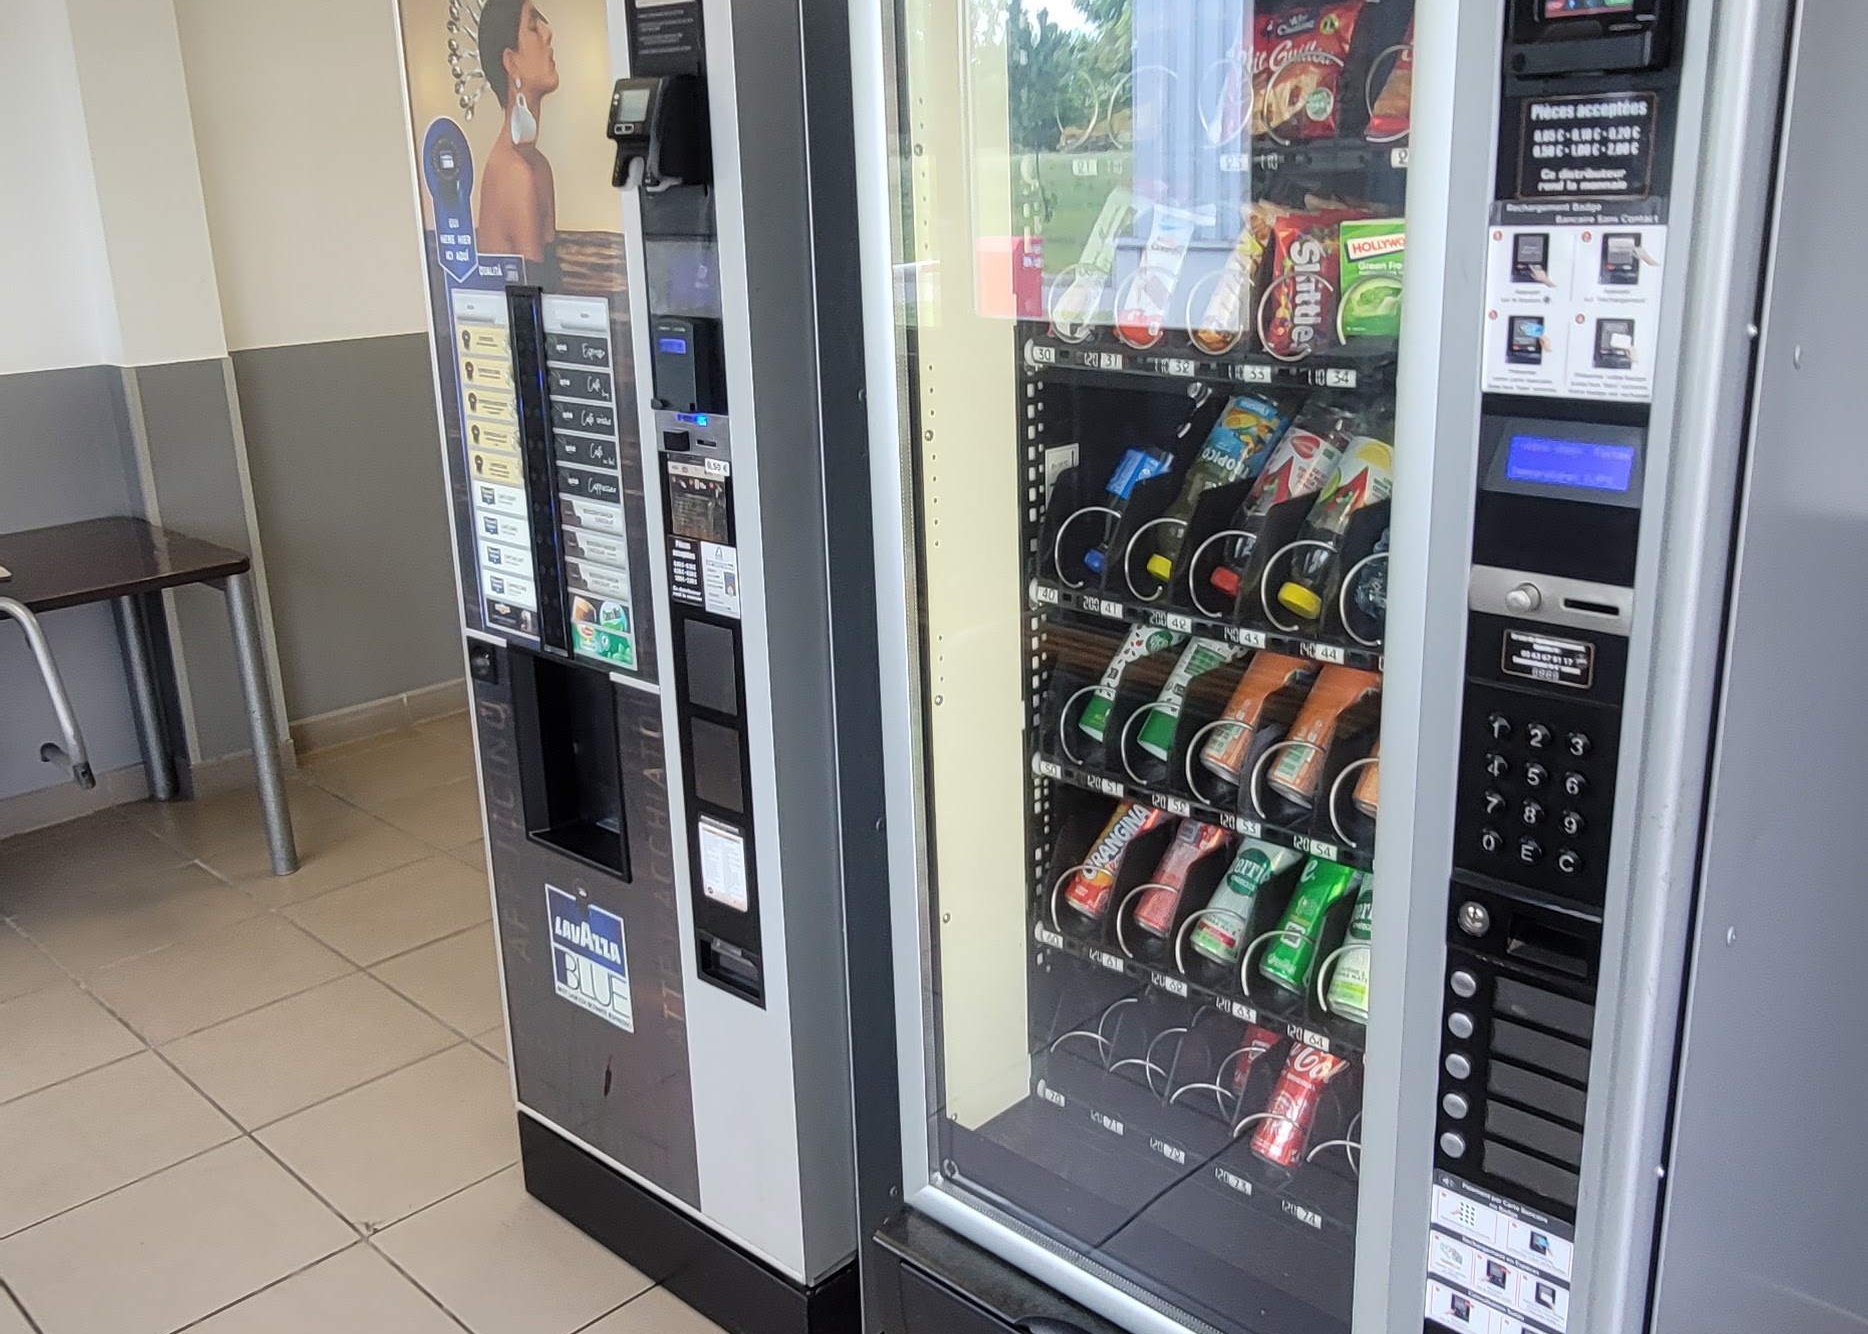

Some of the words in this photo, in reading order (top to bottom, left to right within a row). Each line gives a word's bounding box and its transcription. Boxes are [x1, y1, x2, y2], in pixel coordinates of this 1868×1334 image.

[1530, 103, 1574, 121] Pièces
[1576, 99, 1647, 119] acceptées
[1038, 349, 1050, 360] 30
[1106, 355, 1118, 367] 31
[1333, 371, 1349, 385] 34
[1042, 591, 1055, 601] 40
[1105, 603, 1117, 615] 41
[1172, 619, 1186, 630] 42
[1244, 633, 1259, 645] 43
[1321, 648, 1337, 661] 44
[1529, 729, 1543, 748] 2
[1570, 737, 1584, 756] 3
[1487, 758, 1500, 777] 4
[1526, 768, 1540, 786] 5
[1565, 777, 1579, 795] 6
[1173, 801, 1186, 813] 52
[1486, 796, 1498, 814] 7
[1523, 806, 1537, 824] 8
[1564, 816, 1578, 834] 9
[1242, 822, 1256, 834] 53
[1082, 804, 1152, 880] ORANGINA
[1317, 844, 1331, 857] 54
[1520, 845, 1534, 862] E
[1559, 854, 1575, 873] C
[555, 915, 622, 964] LAVAZZA
[1047, 934, 1059, 945] 60
[1106, 955, 1118, 966] 61
[558, 950, 630, 1018] BLUE
[1237, 1006, 1251, 1017] 63
[1310, 1035, 1324, 1048] 64
